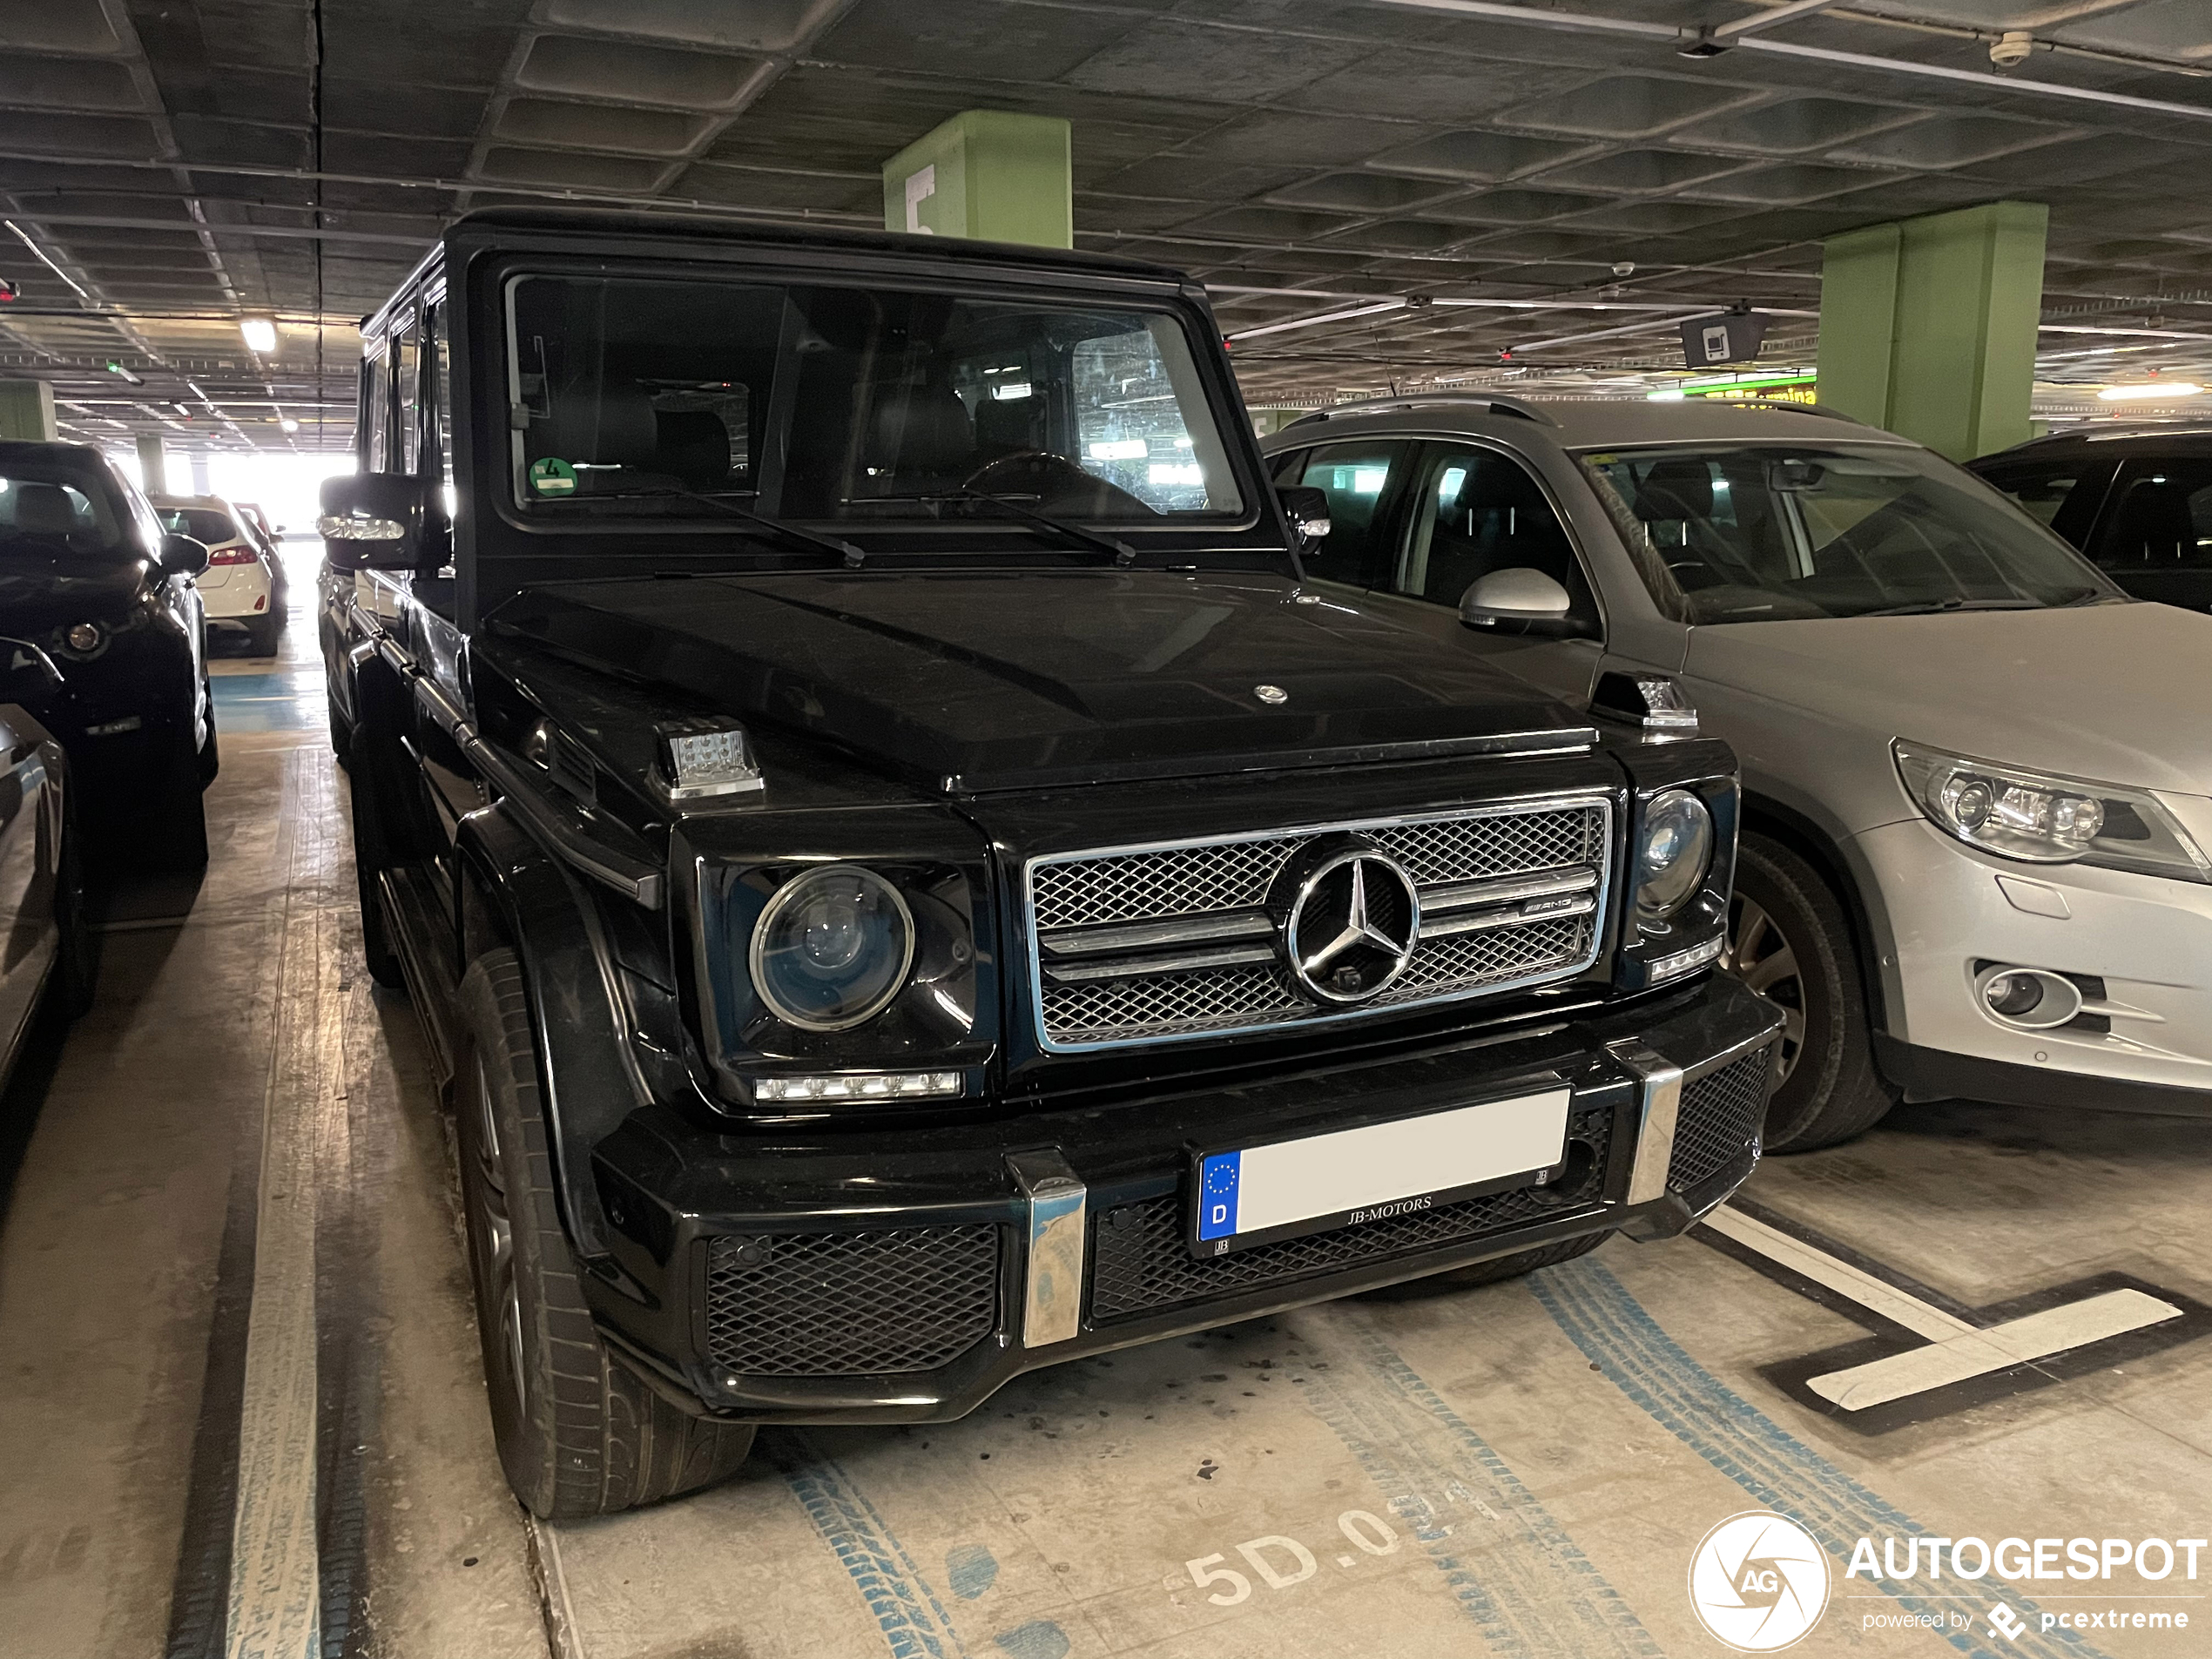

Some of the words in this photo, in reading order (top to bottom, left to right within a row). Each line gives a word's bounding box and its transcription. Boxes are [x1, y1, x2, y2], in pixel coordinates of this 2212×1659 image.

[545, 459, 560, 477] 4
[1538, 898, 1572, 911] AMG
[1212, 1204, 1227, 1224] D
[1347, 1196, 1433, 1225] JB-MOTORS
